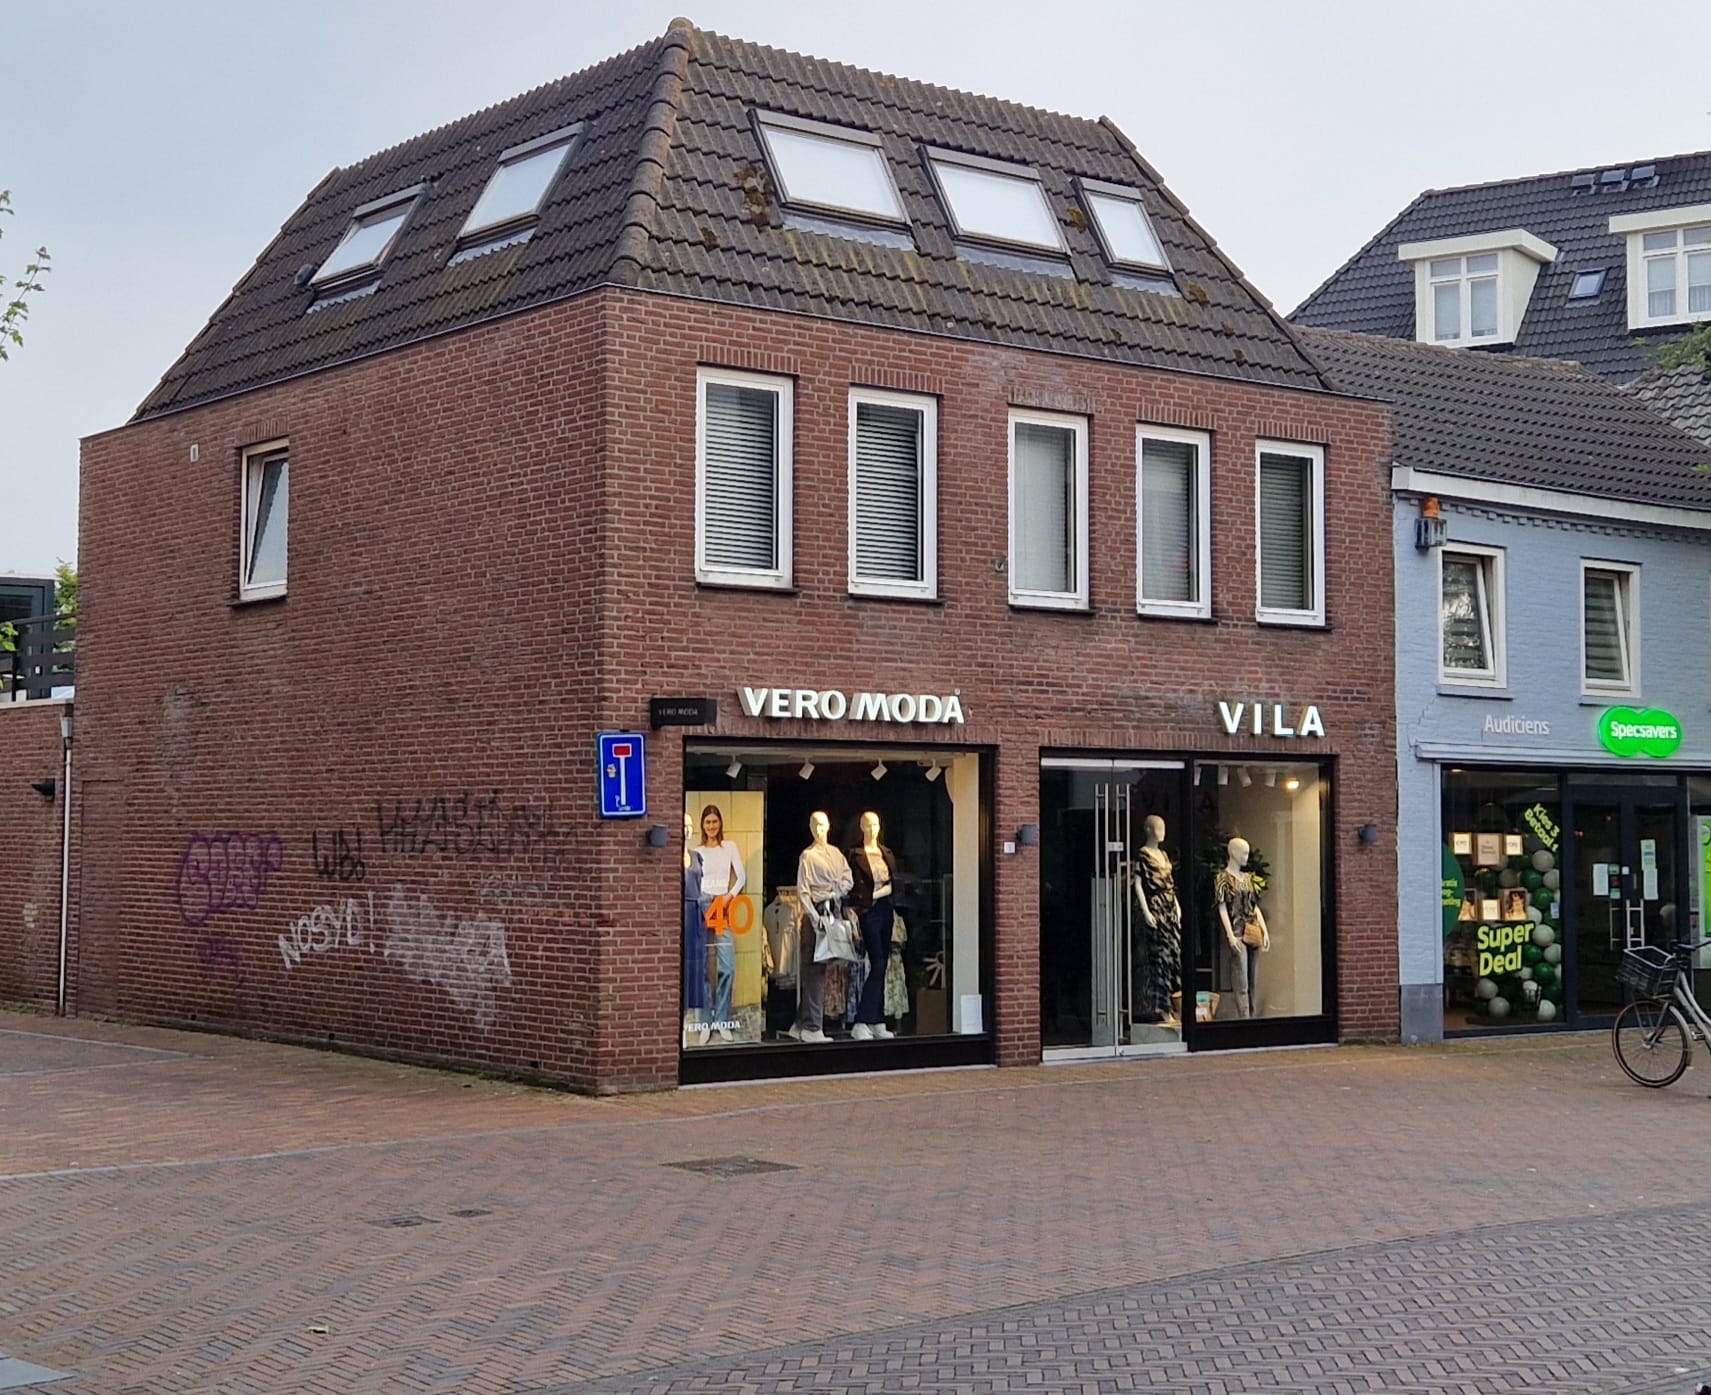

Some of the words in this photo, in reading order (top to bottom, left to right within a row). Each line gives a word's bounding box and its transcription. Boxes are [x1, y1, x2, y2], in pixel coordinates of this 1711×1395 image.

[740, 687, 846, 720] VERO
[849, 692, 965, 724] MODA
[1218, 701, 1325, 736] VILA
[1485, 714, 1550, 735] Audiciens
[1611, 721, 1678, 740] Specsavers
[1533, 803, 1553, 830] Kies
[1550, 825, 1560, 837] 3
[704, 894, 755, 937] 40
[1477, 923, 1535, 952] Super
[1479, 945, 1523, 976] Deal
[710, 1020, 741, 1031] MODA
